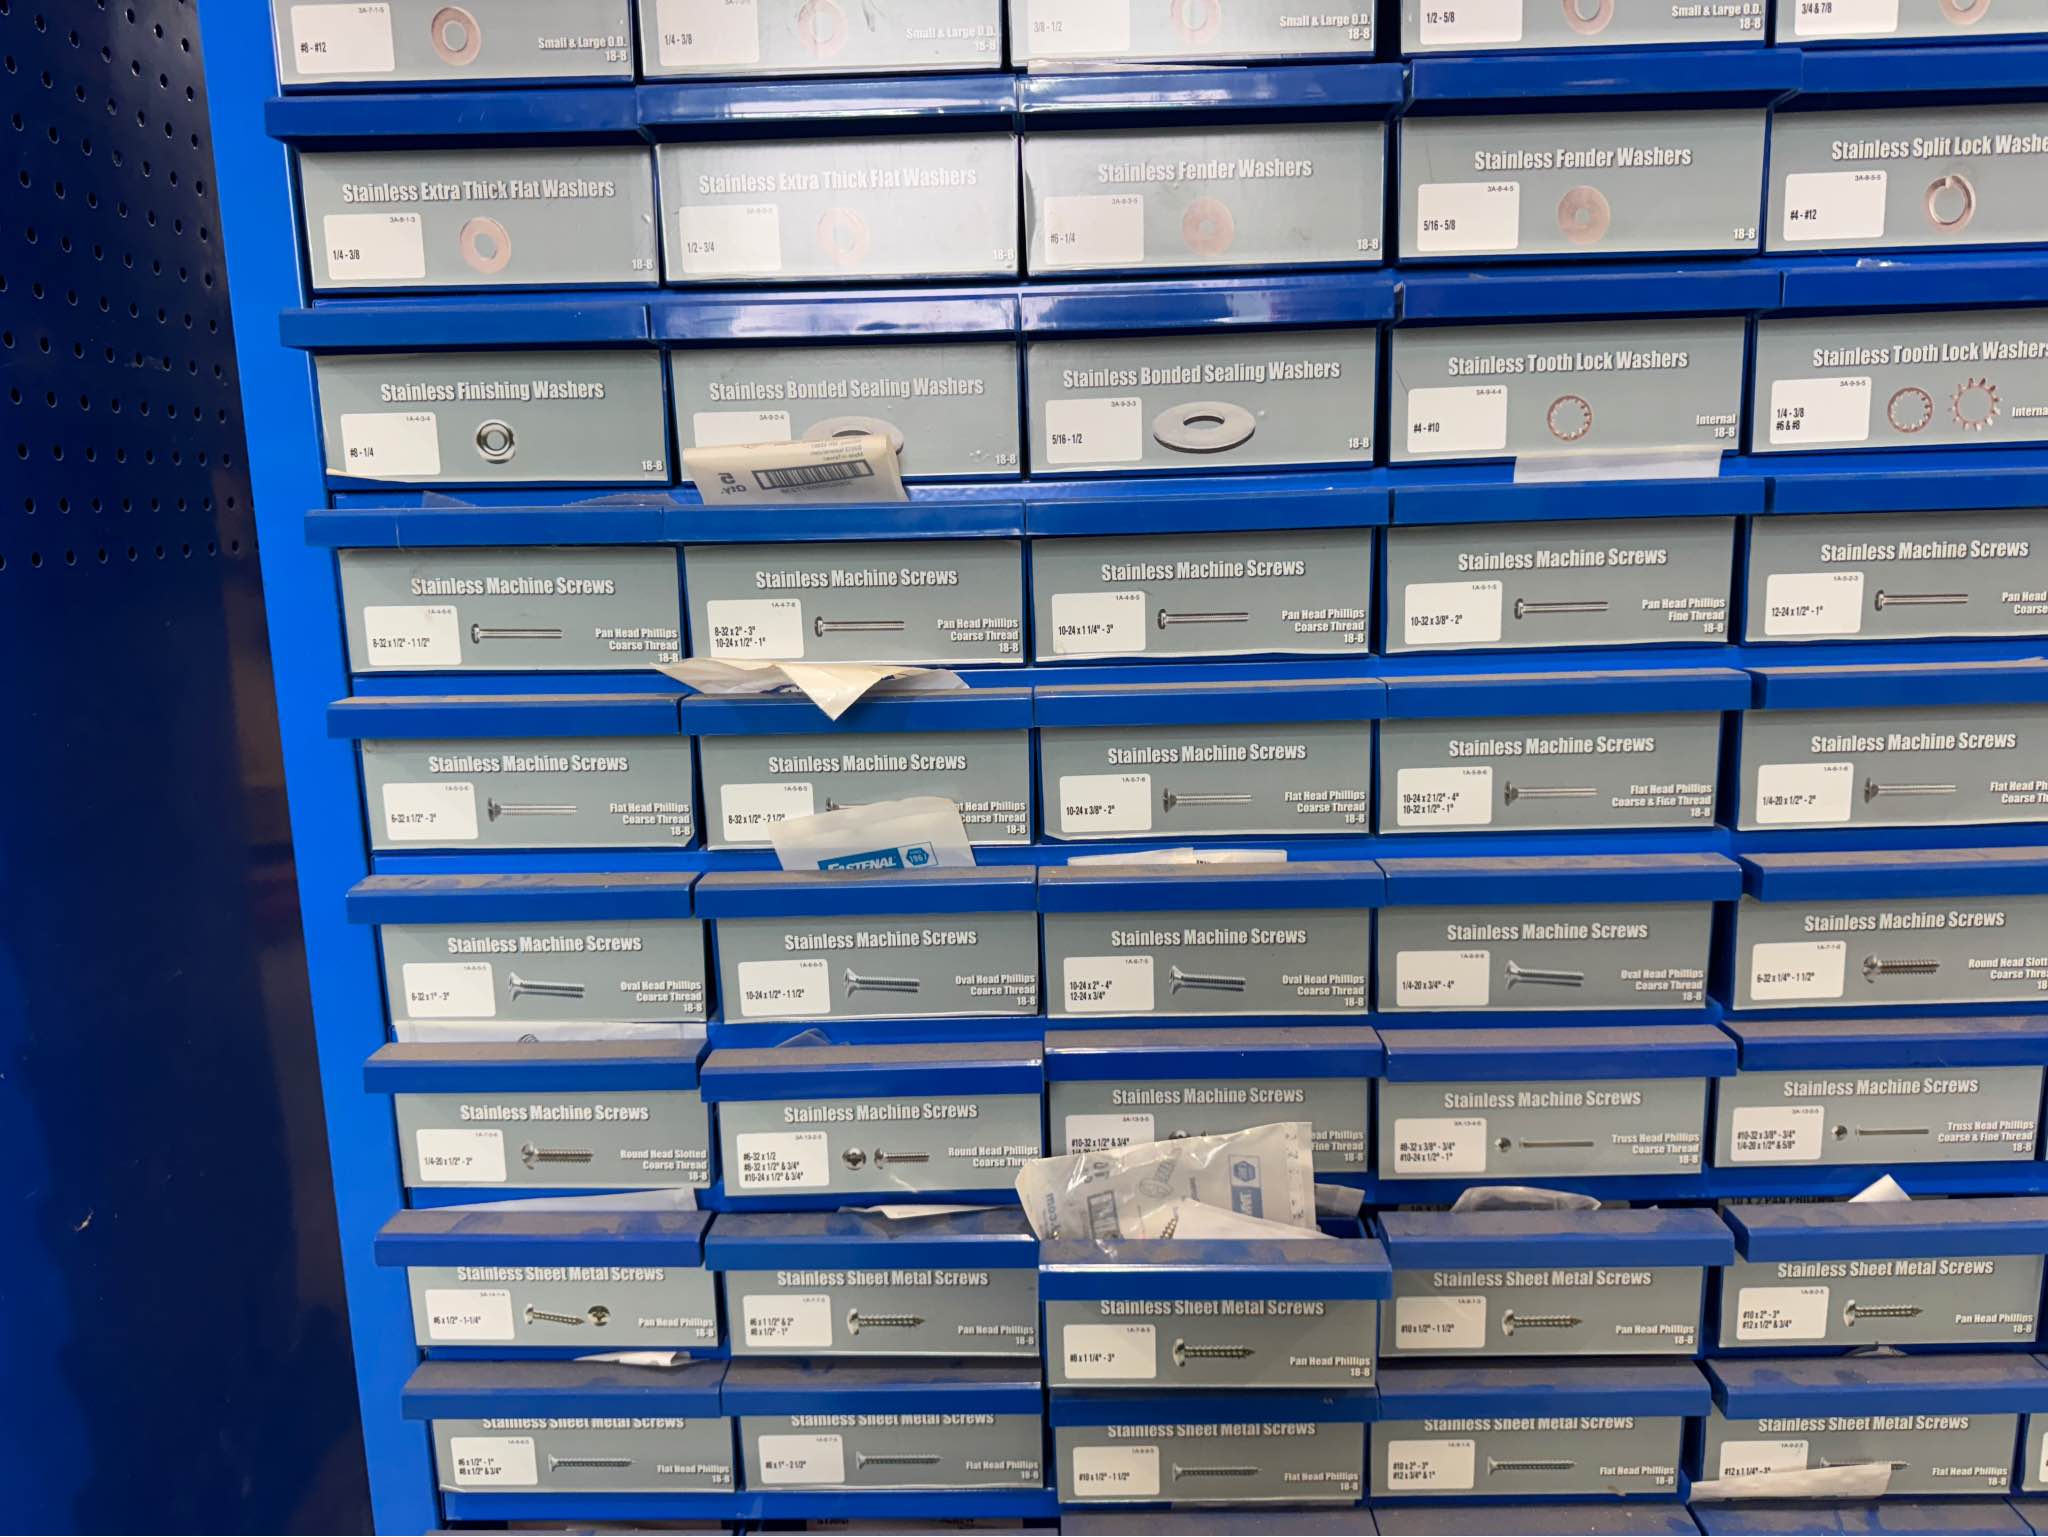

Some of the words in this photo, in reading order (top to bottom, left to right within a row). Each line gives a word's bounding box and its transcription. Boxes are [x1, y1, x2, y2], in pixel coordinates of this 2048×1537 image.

[1672, 5, 1702, 17] Small
[1703, 6, 1710, 16] &
[1712, 5, 1741, 17] Large
[1743, 4, 1762, 15] O.D.
[1426, 12, 1438, 24] 1/2
[1443, 11, 1455, 24] 5/8
[1740, 18, 1762, 30] 18-8
[538, 37, 567, 49] Small
[569, 38, 577, 48] &
[578, 37, 606, 49] Large
[608, 36, 627, 47] O.D.
[605, 50, 627, 61] 18-8
[1832, 141, 1909, 159] Stainless
[1912, 138, 1951, 158] Split
[1954, 136, 1992, 155] Lock
[1475, 151, 1553, 170] Stainless
[1556, 149, 1614, 168] Fender
[1617, 148, 1691, 166] Washers
[1097, 163, 1175, 182] Stainless
[1178, 160, 1235, 180] Fender
[1238, 159, 1312, 178] Washers
[700, 175, 776, 193] Stainless
[779, 173, 820, 190] Extra
[822, 172, 869, 189] Thick
[870, 171, 901, 188] Flat
[903, 170, 977, 187] Washers
[342, 184, 418, 202] Stainless
[420, 182, 461, 200] Extra
[462, 181, 508, 199] Thick
[510, 180, 540, 198] Flat
[542, 180, 615, 197] Washers
[1790, 210, 1799, 221] #4
[1804, 209, 1817, 220] #12
[1424, 220, 1439, 232] 5/16
[1444, 219, 1456, 231] 5/8
[1734, 228, 1758, 239] 18-8
[1357, 239, 1379, 251] 18-8
[333, 250, 344, 260] 1/4
[349, 249, 361, 260] 3/8
[632, 259, 653, 270] 18-8
[1813, 348, 1889, 366] Stainless
[1893, 345, 1939, 363] Tooth
[1942, 343, 1979, 361] Lock
[1448, 356, 1524, 375] Stainless
[1528, 354, 1573, 372] Tooth
[1576, 352, 1613, 370] Lock
[1616, 351, 1688, 369] Washers
[1063, 369, 1138, 387] Stainless
[1141, 366, 1201, 385] Bonded
[1204, 364, 1265, 382] Sealing
[1268, 362, 1340, 379] Washers
[380, 384, 455, 401] Stainless
[457, 382, 530, 400] Finishing
[532, 381, 604, 398] Washers
[710, 383, 784, 400] Stainless
[787, 380, 847, 398] Bonded
[850, 379, 910, 398] Sealing
[913, 378, 984, 395] Washers
[1696, 414, 1736, 425] Internal
[1714, 426, 1735, 438] 18-8
[1052, 434, 1067, 445] 5/16
[1072, 433, 1083, 444] 1/2
[1348, 437, 1369, 448] 18-8
[642, 460, 663, 471] 18-8
[1821, 544, 1896, 561] Stainless
[1898, 542, 1967, 559] Machine
[1970, 541, 2029, 557] Screws
[1458, 553, 1533, 570] Stainless
[1536, 550, 1605, 567] Machine
[1608, 549, 1667, 565] Screws
[756, 571, 829, 588] Stainless
[831, 570, 898, 586] Machine
[900, 569, 958, 585] Screws
[1668, 611, 1689, 621] Fine
[1690, 610, 1725, 620] Thread
[937, 619, 955, 629] Pan
[956, 619, 981, 629] Head
[982, 618, 1018, 631] Phillips
[950, 631, 984, 641] Coarse
[985, 631, 1019, 640] Thread
[999, 642, 1019, 653] 18-8
[768, 757, 840, 773] Stainless
[843, 755, 908, 771] Machine
[910, 754, 966, 770] Screws
[1284, 792, 1302, 801] Flat
[1304, 791, 1328, 801] Head
[1329, 790, 1365, 802] Phillips
[1297, 803, 1330, 813] Coarse
[1332, 802, 1365, 812] Thread
[1344, 814, 1365, 823] 18-8
[1804, 916, 1876, 931] Stainless
[1879, 913, 1945, 929] Machine
[1948, 912, 2005, 927] Screws
[448, 938, 517, 953] Stainless
[520, 937, 584, 952] Machine
[586, 936, 642, 951] Screws
[1282, 975, 1302, 984] Oval
[1304, 975, 1328, 984] Head
[1329, 975, 1364, 984] Phillips
[1070, 992, 1087, 1001] 12-24
[1092, 991, 1106, 1001] 3/4"
[1297, 986, 1330, 996] Coarse
[1332, 986, 1364, 995] Thread
[1345, 997, 1364, 1007] 18-8
[784, 1107, 854, 1122] Stainless
[856, 1105, 920, 1120] Machine
[923, 1104, 977, 1118] Screws
[1778, 1263, 1847, 1278] Stainless
[1850, 1262, 1893, 1276] Sheet
[1895, 1261, 1937, 1275] Metal
[1939, 1260, 1994, 1274] Screws
[1100, 1300, 1172, 1315] Stainless
[1175, 1300, 1219, 1315] Sheet
[1222, 1301, 1264, 1314] Metal
[1268, 1301, 1324, 1315] Screws
[1290, 1357, 1308, 1366] Pan
[1309, 1357, 1333, 1366] Head
[1335, 1357, 1370, 1366] Phillips
[1350, 1368, 1370, 1377] 18-8
[1758, 1419, 1826, 1432] Stainless
[1828, 1418, 1870, 1431] Sheet
[1873, 1416, 1914, 1430] Metal
[1916, 1416, 1969, 1430] Screws
